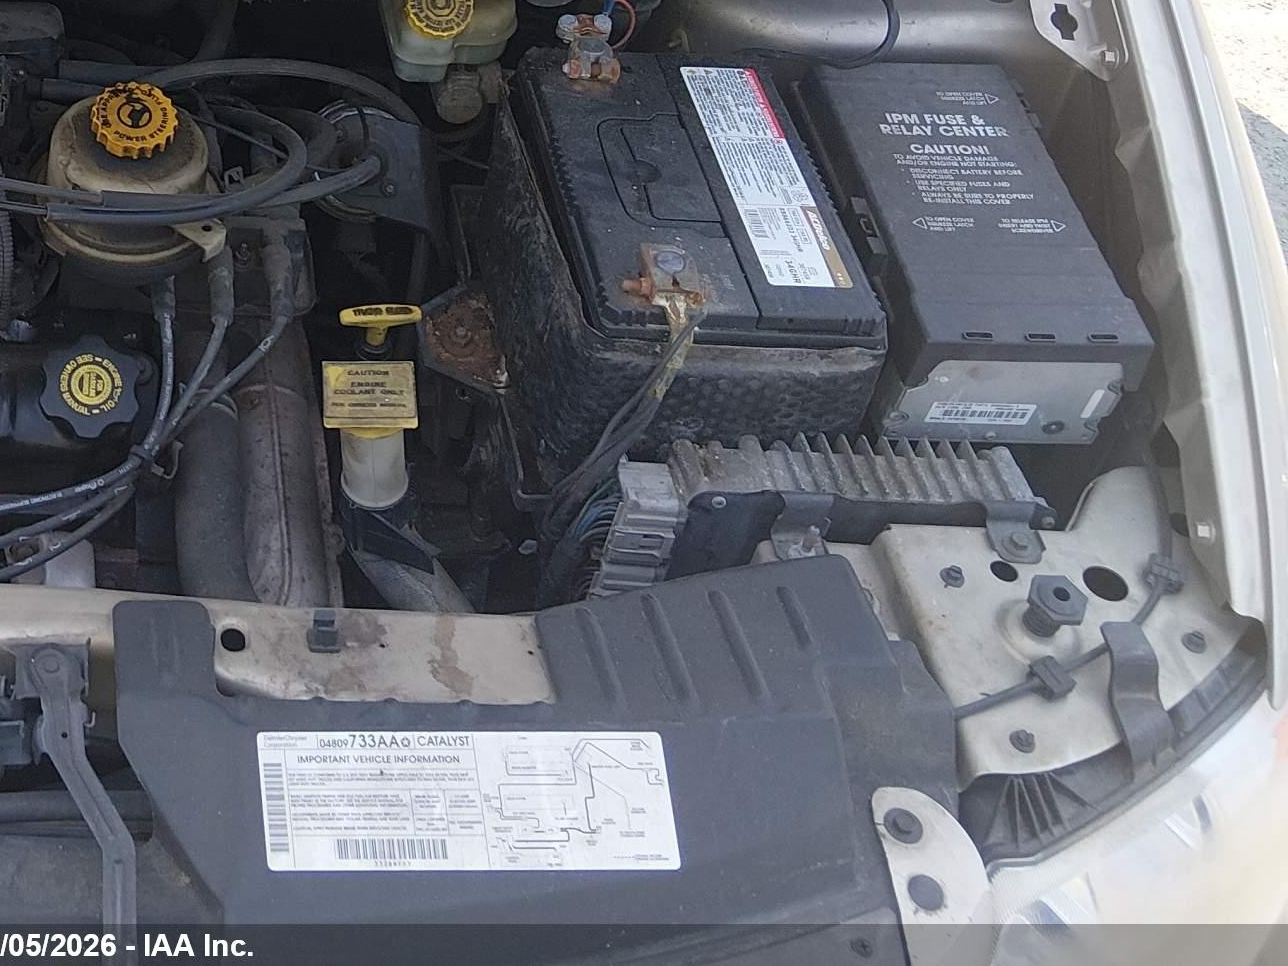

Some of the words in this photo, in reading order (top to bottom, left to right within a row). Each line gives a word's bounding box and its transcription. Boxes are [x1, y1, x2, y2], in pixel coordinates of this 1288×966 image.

[114, 130, 147, 142] POWER
[149, 107, 169, 139] STEERING
[885, 113, 920, 124] IPM
[923, 114, 967, 125] FUSE
[970, 114, 985, 125] &
[879, 124, 932, 136] RELAY
[939, 125, 1009, 137] CENTER
[910, 144, 990, 155] CAUTION!
[806, 210, 831, 250] ACDelco
[75, 354, 93, 363] SEE
[102, 359, 122, 387] ENGINE
[62, 392, 91, 415] MANUAL
[100, 398, 115, 411] OIL
[417, 735, 470, 747] CATALYST
[297, 755, 351, 764] IMPORTANT
[354, 755, 392, 764] VEHICLE
[394, 755, 460, 764] INFORMATION
